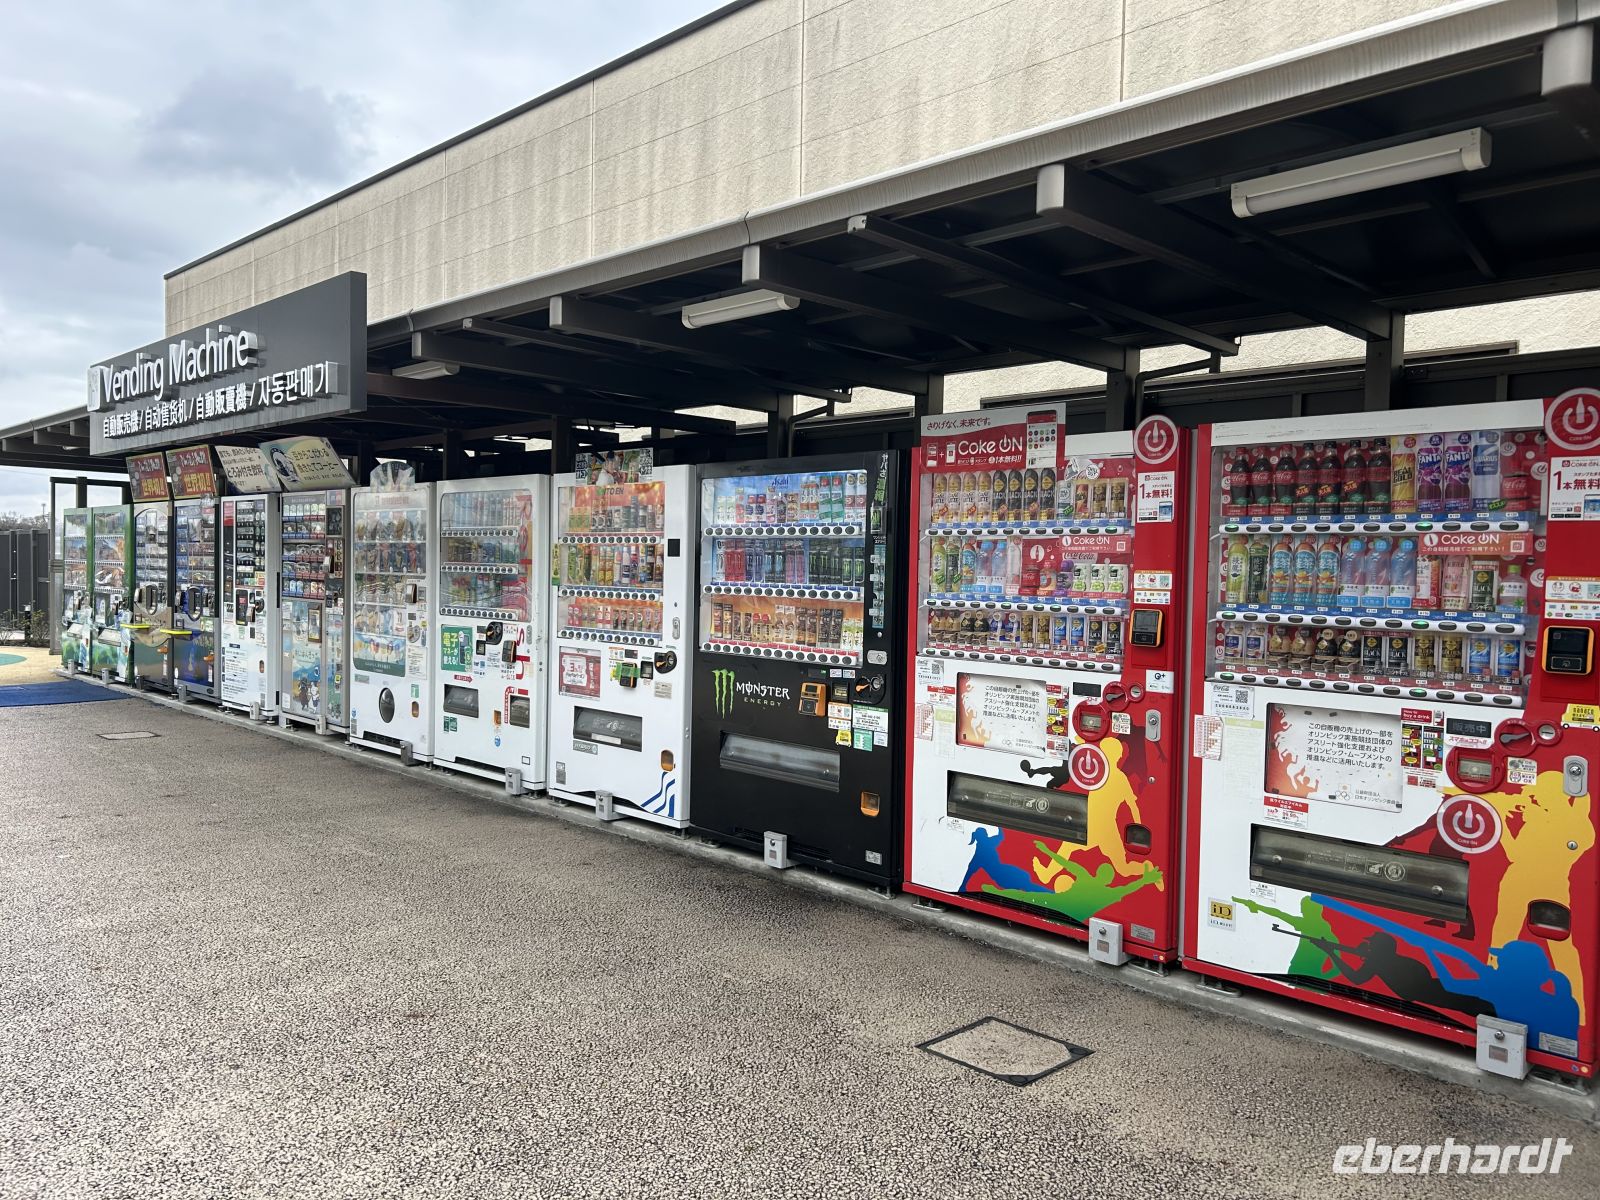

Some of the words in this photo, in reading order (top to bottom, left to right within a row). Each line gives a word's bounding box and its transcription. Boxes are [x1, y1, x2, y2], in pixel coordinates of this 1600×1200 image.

[103, 352, 163, 401] Vending
[169, 327, 252, 386] Machine
[259, 362, 330, 406] 자동판매기
[958, 440, 996, 455] Coke
[999, 434, 1023, 453] ON
[1418, 453, 1442, 465] FANTA
[1445, 451, 1470, 463] FANTA
[1073, 536, 1095, 545] Coke
[1096, 535, 1110, 545] ON
[1441, 534, 1476, 545] Coke
[1478, 533, 1500, 545] ON
[443, 632, 458, 647] 電子
[736, 681, 790, 700] MONSTER
[744, 697, 781, 707] ENERGY
